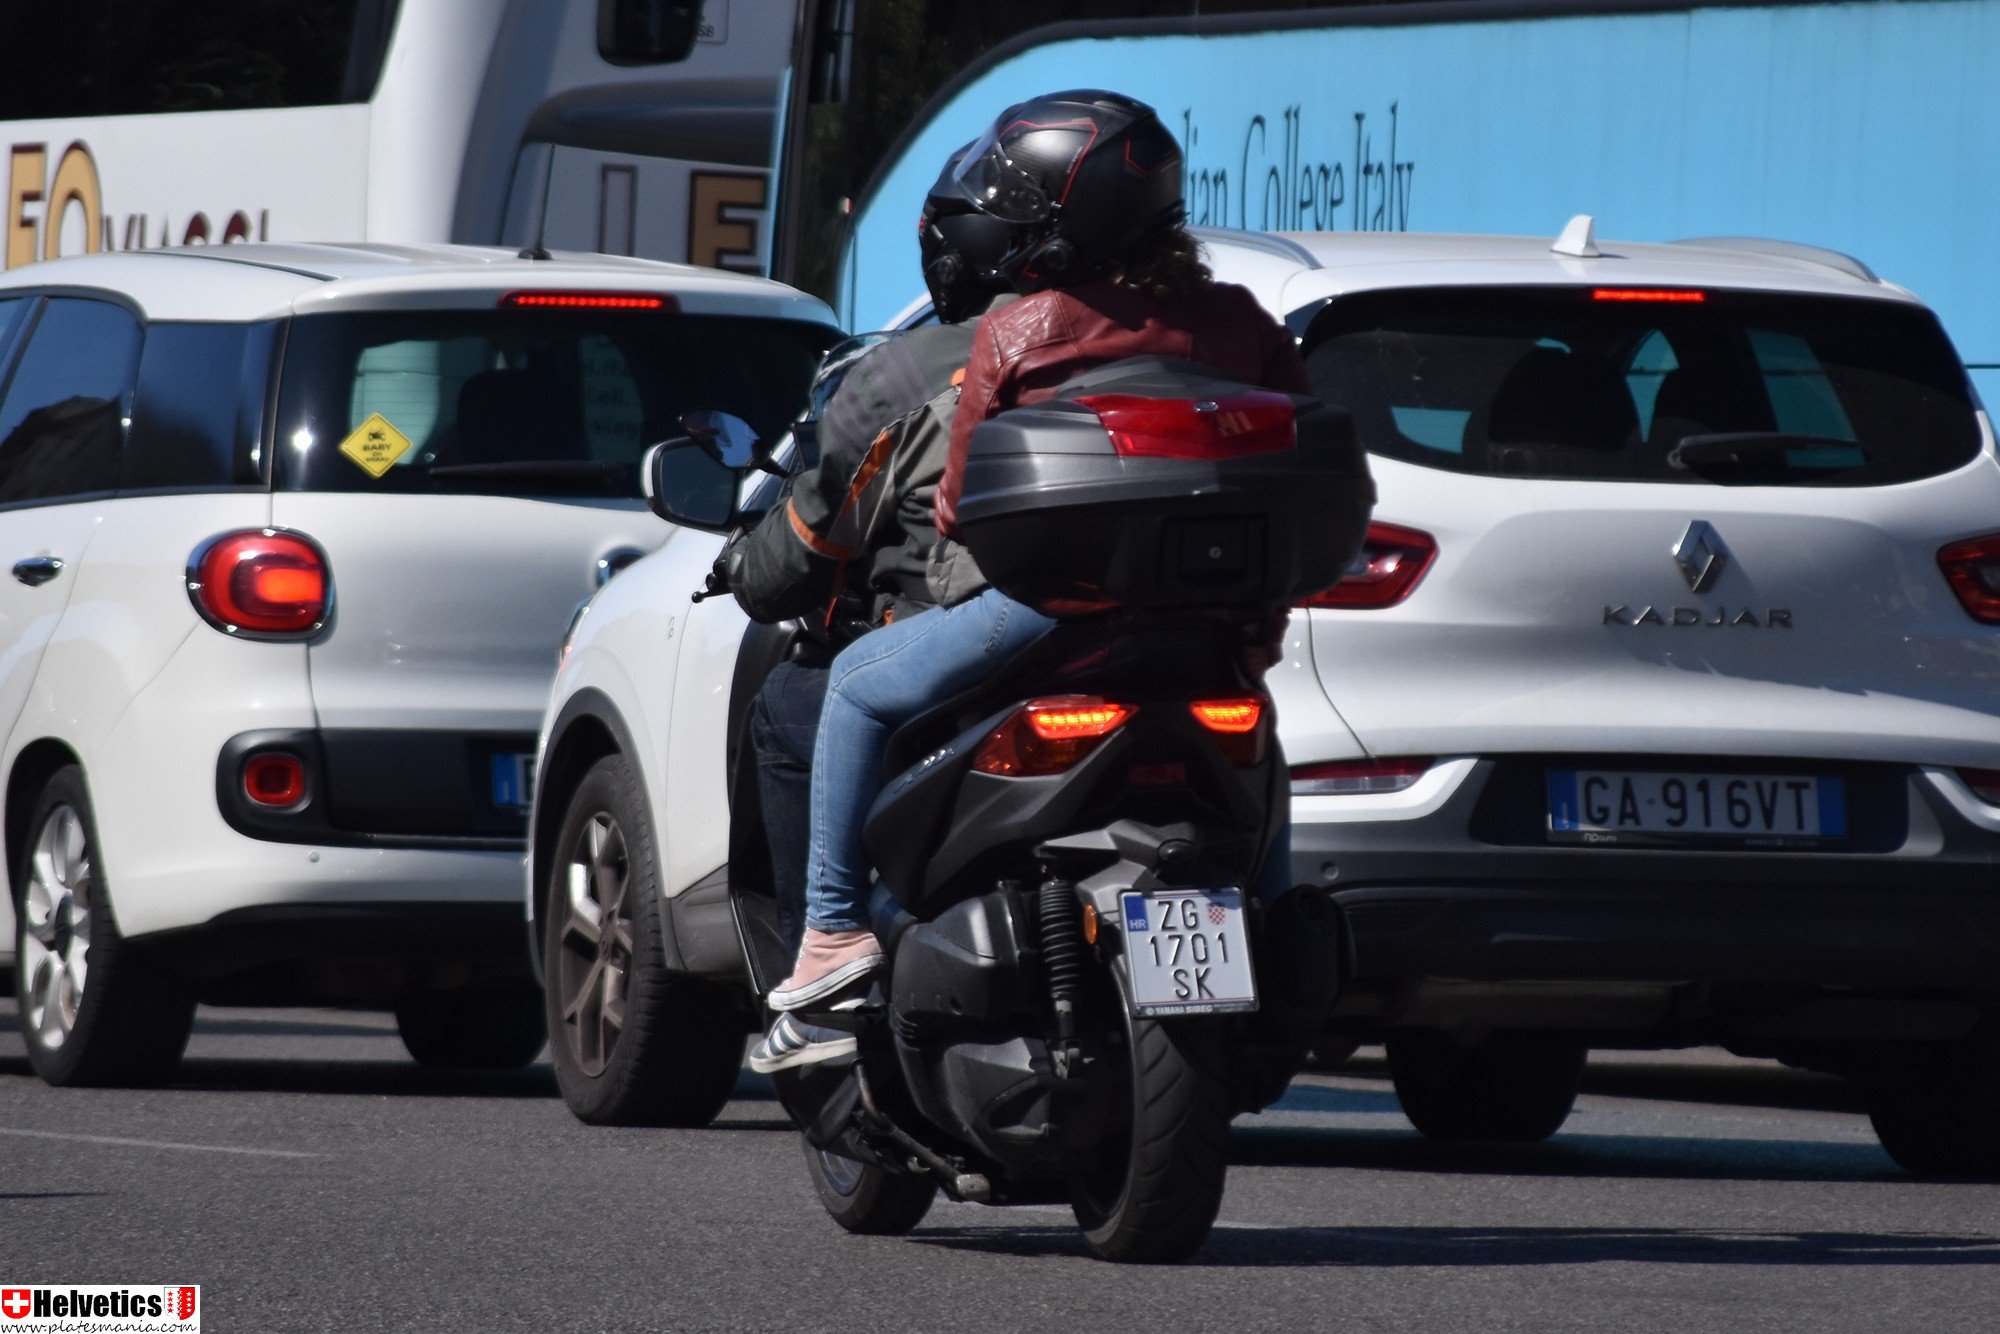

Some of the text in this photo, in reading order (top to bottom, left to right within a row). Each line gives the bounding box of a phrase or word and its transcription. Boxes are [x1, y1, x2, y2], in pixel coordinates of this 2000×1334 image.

[1241, 103, 1345, 232] College
[1355, 100, 1415, 232] Italy
[1603, 604, 1793, 628] KADJAR
[1584, 776, 1810, 830] GA 916VT
[1130, 919, 1147, 930] HR
[1158, 899, 1198, 931] ZG
[1150, 932, 1228, 967] 1701
[1173, 967, 1214, 1000] SK
